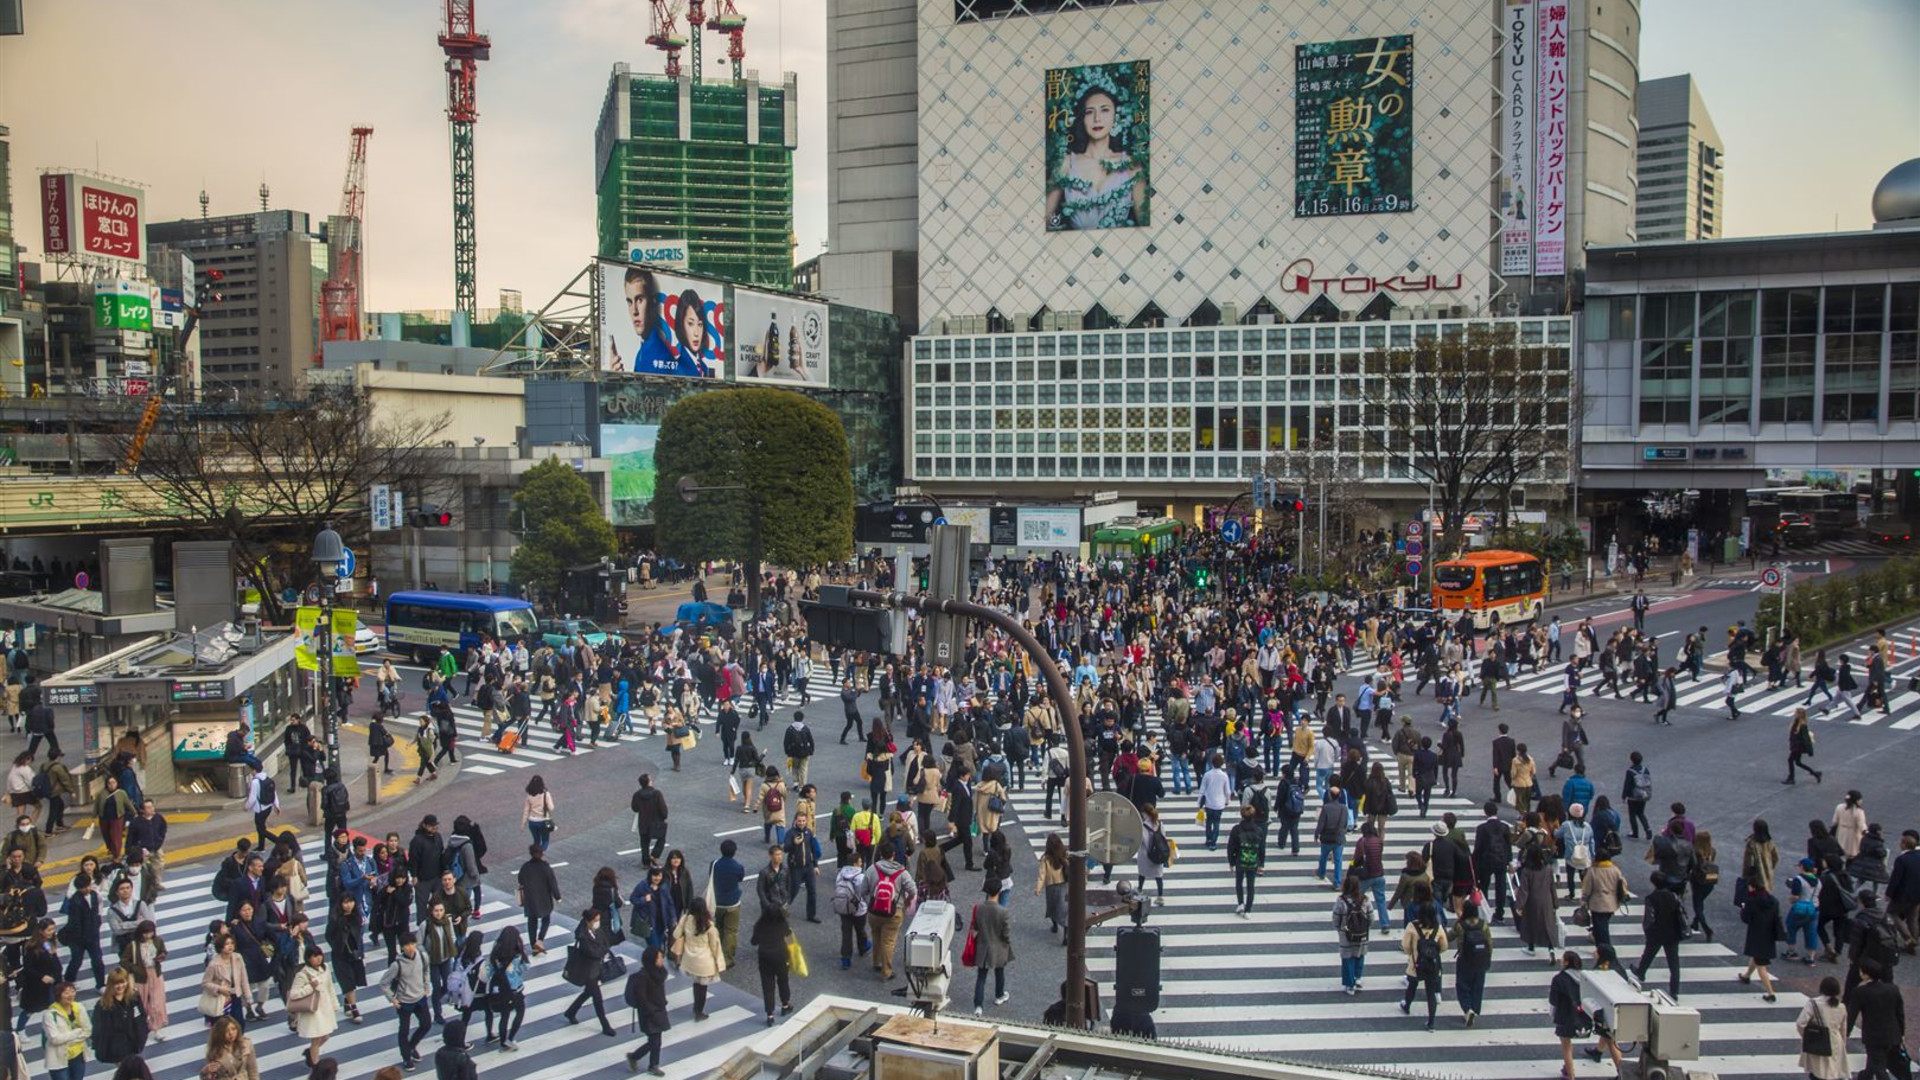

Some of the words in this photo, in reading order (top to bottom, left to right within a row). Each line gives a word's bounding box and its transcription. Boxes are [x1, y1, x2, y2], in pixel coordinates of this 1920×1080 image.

[1512, 8, 1524, 66] TOKYU
[1299, 78, 1353, 93] 松嶋菜々子
[1355, 36, 1413, 117] 女の
[1512, 70, 1524, 118] CARD
[1047, 70, 1075, 143] 散れ。
[1135, 61, 1149, 155] 気高く咲いて
[1548, 5, 1566, 233] 婦人靴・ハンドバッグバーゲン
[1327, 96, 1373, 196] 勲章
[1512, 120, 1523, 181] クラブキュウ
[46, 177, 64, 250] ほけんの窓口
[84, 193, 136, 218] ほけんの
[98, 216, 129, 237] 窓口
[92, 237, 132, 253] グループ
[644, 248, 684, 261] STARTS
[1311, 274, 1462, 295] TOKYU
[102, 296, 113, 326] レイク
[120, 303, 148, 320] レイク
[740, 344, 756, 353] WORK
[805, 352, 821, 360] CRAFT
[805, 361, 818, 369] BOSS
[607, 394, 630, 415] JR
[28, 492, 54, 507] JR
[379, 488, 388, 527] 渋谷駅前
[49, 694, 79, 704] 渋谷駅
